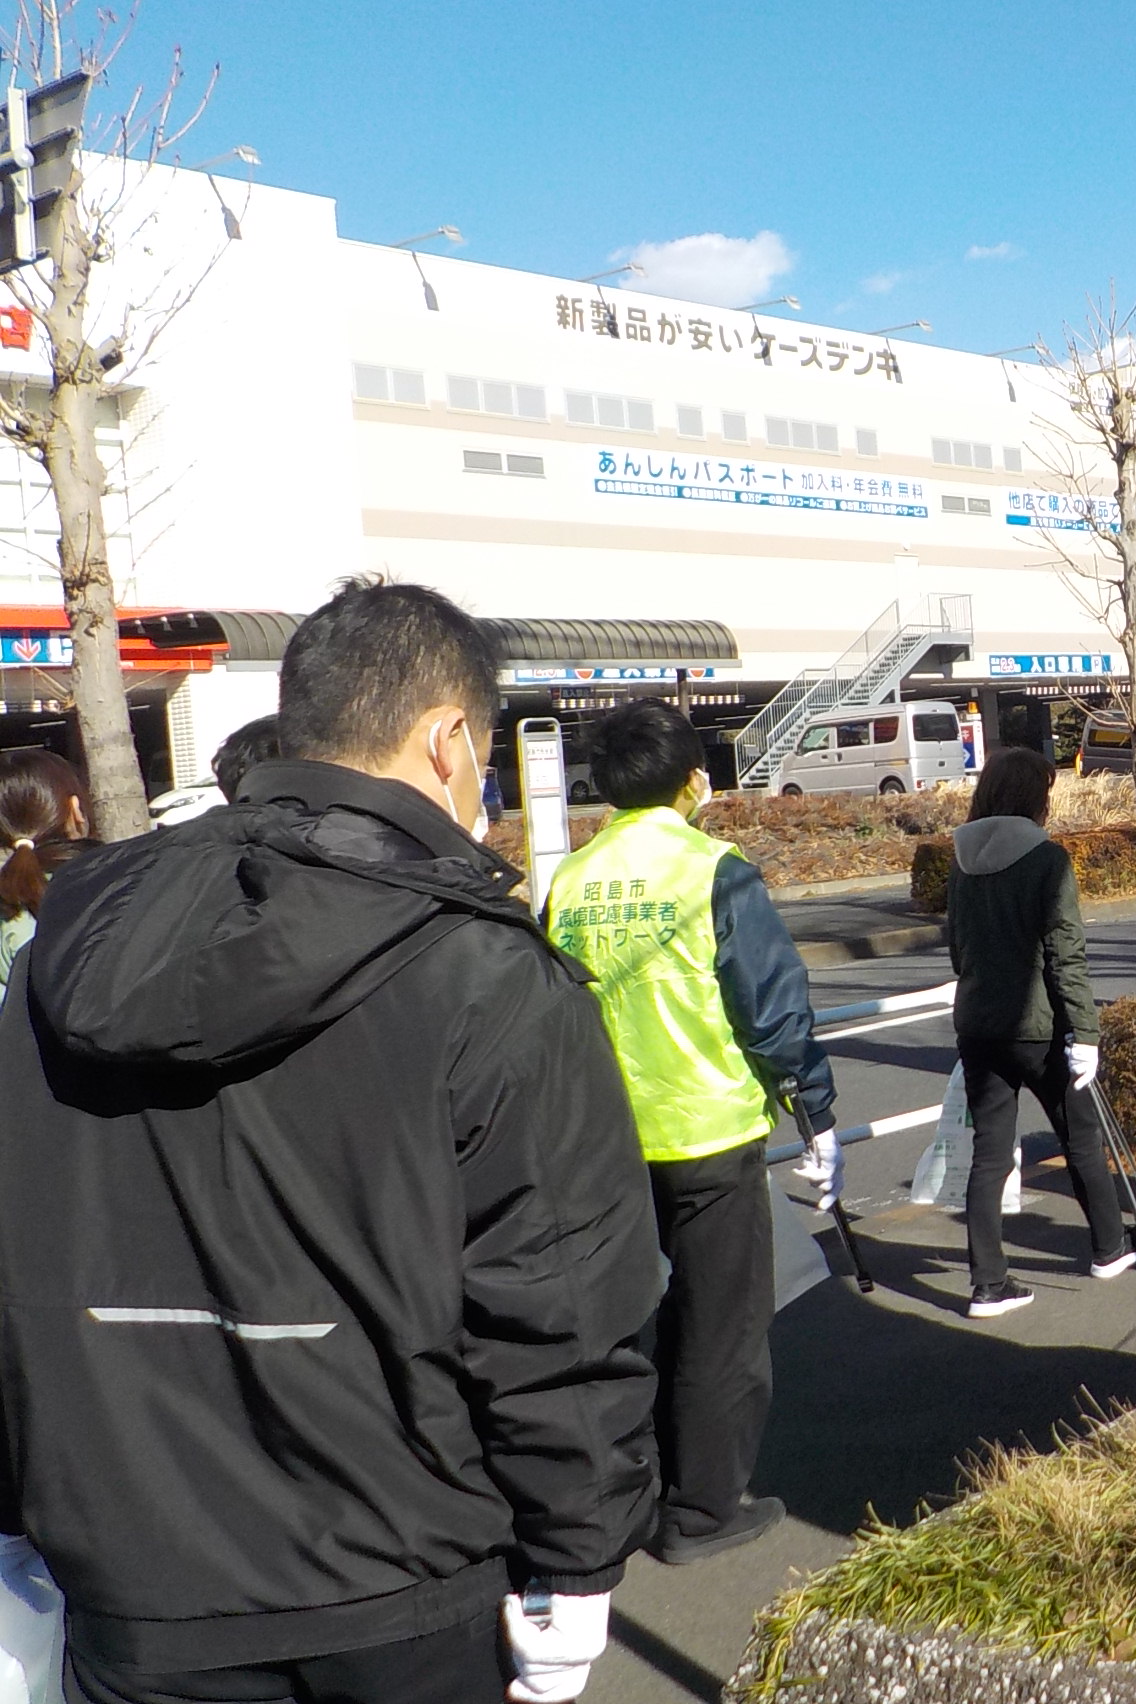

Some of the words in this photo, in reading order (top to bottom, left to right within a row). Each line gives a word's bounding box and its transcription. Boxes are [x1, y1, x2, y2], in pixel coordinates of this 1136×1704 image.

[584, 878, 646, 901] 昭島市
[558, 901, 678, 928] 環境配慮事業者
[559, 926, 676, 951] ネットワーク
